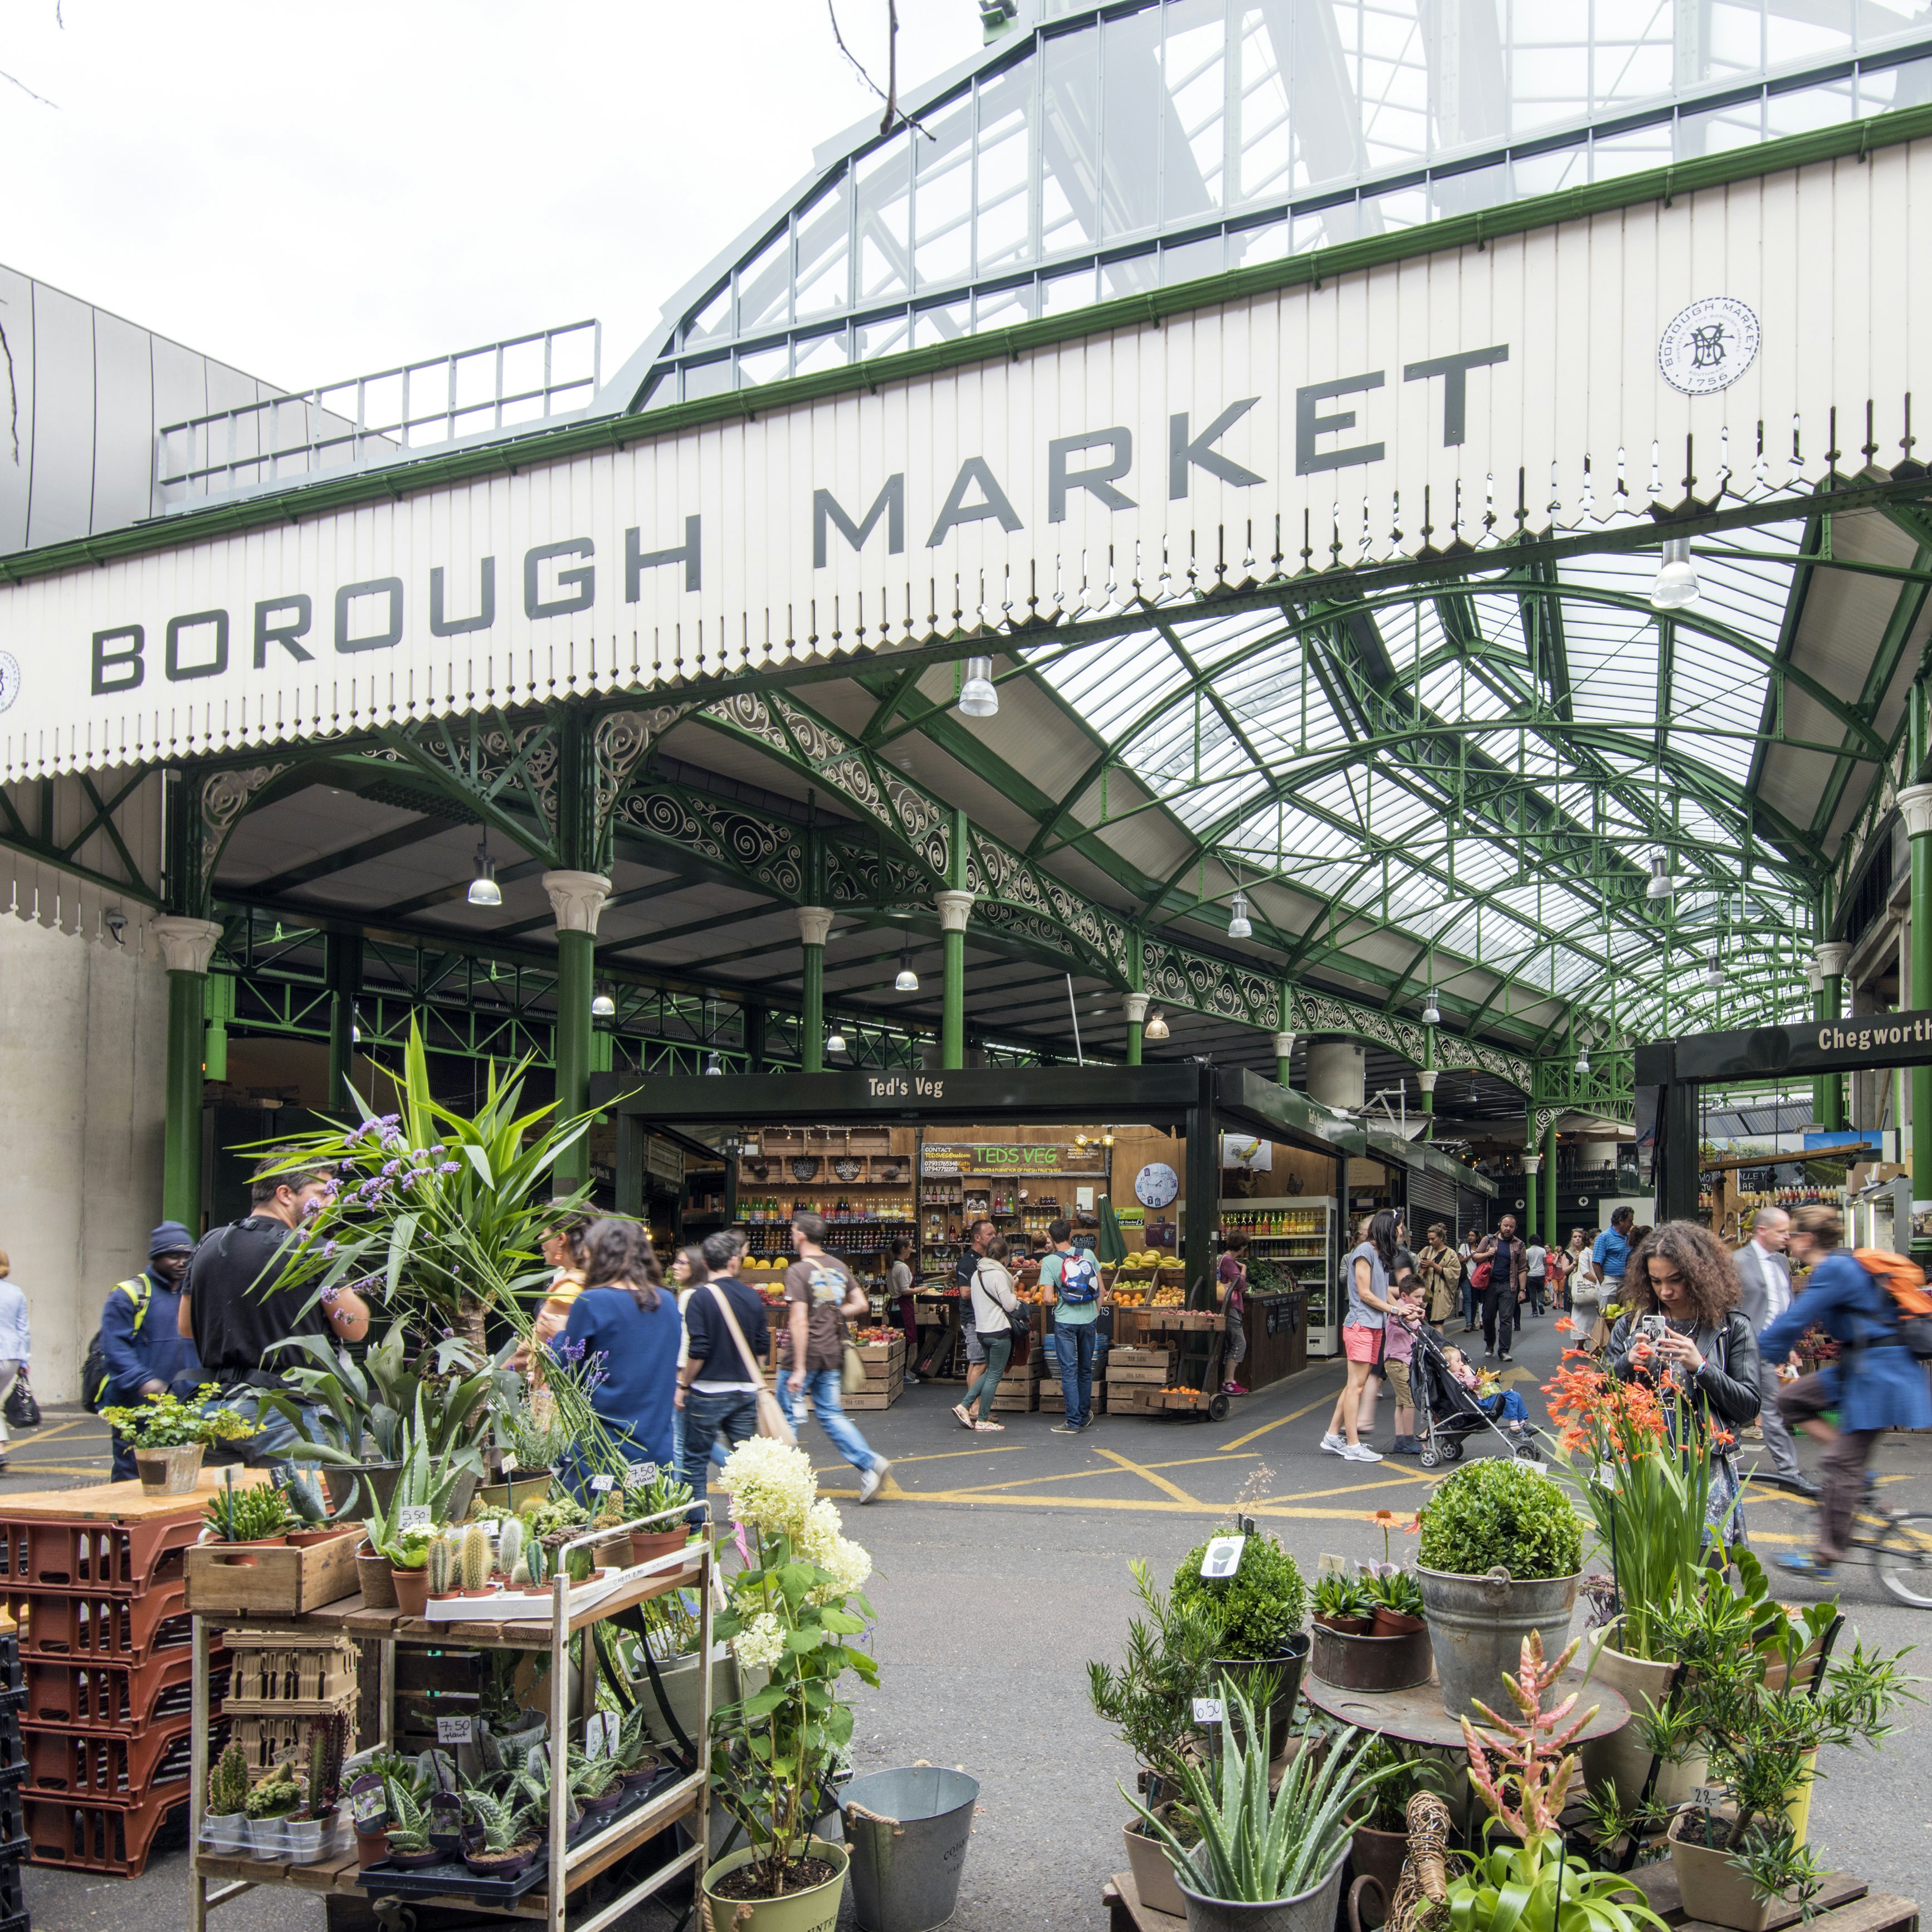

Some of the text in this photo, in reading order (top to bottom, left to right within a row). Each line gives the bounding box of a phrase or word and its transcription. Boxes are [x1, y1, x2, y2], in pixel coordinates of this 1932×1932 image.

[1664, 303, 1754, 367] BOROUGH MARKET
[1687, 372, 1728, 386] 1756
[91, 343, 1510, 696] BOROUGH MARKET
[869, 1077, 943, 1098] Ted's Veg
[1023, 1148, 1057, 1164] VEG
[1739, 1172, 1766, 1180] ALLEY
[1195, 1698, 1220, 1719] 6.50
[440, 1720, 470, 1731] 7.50
